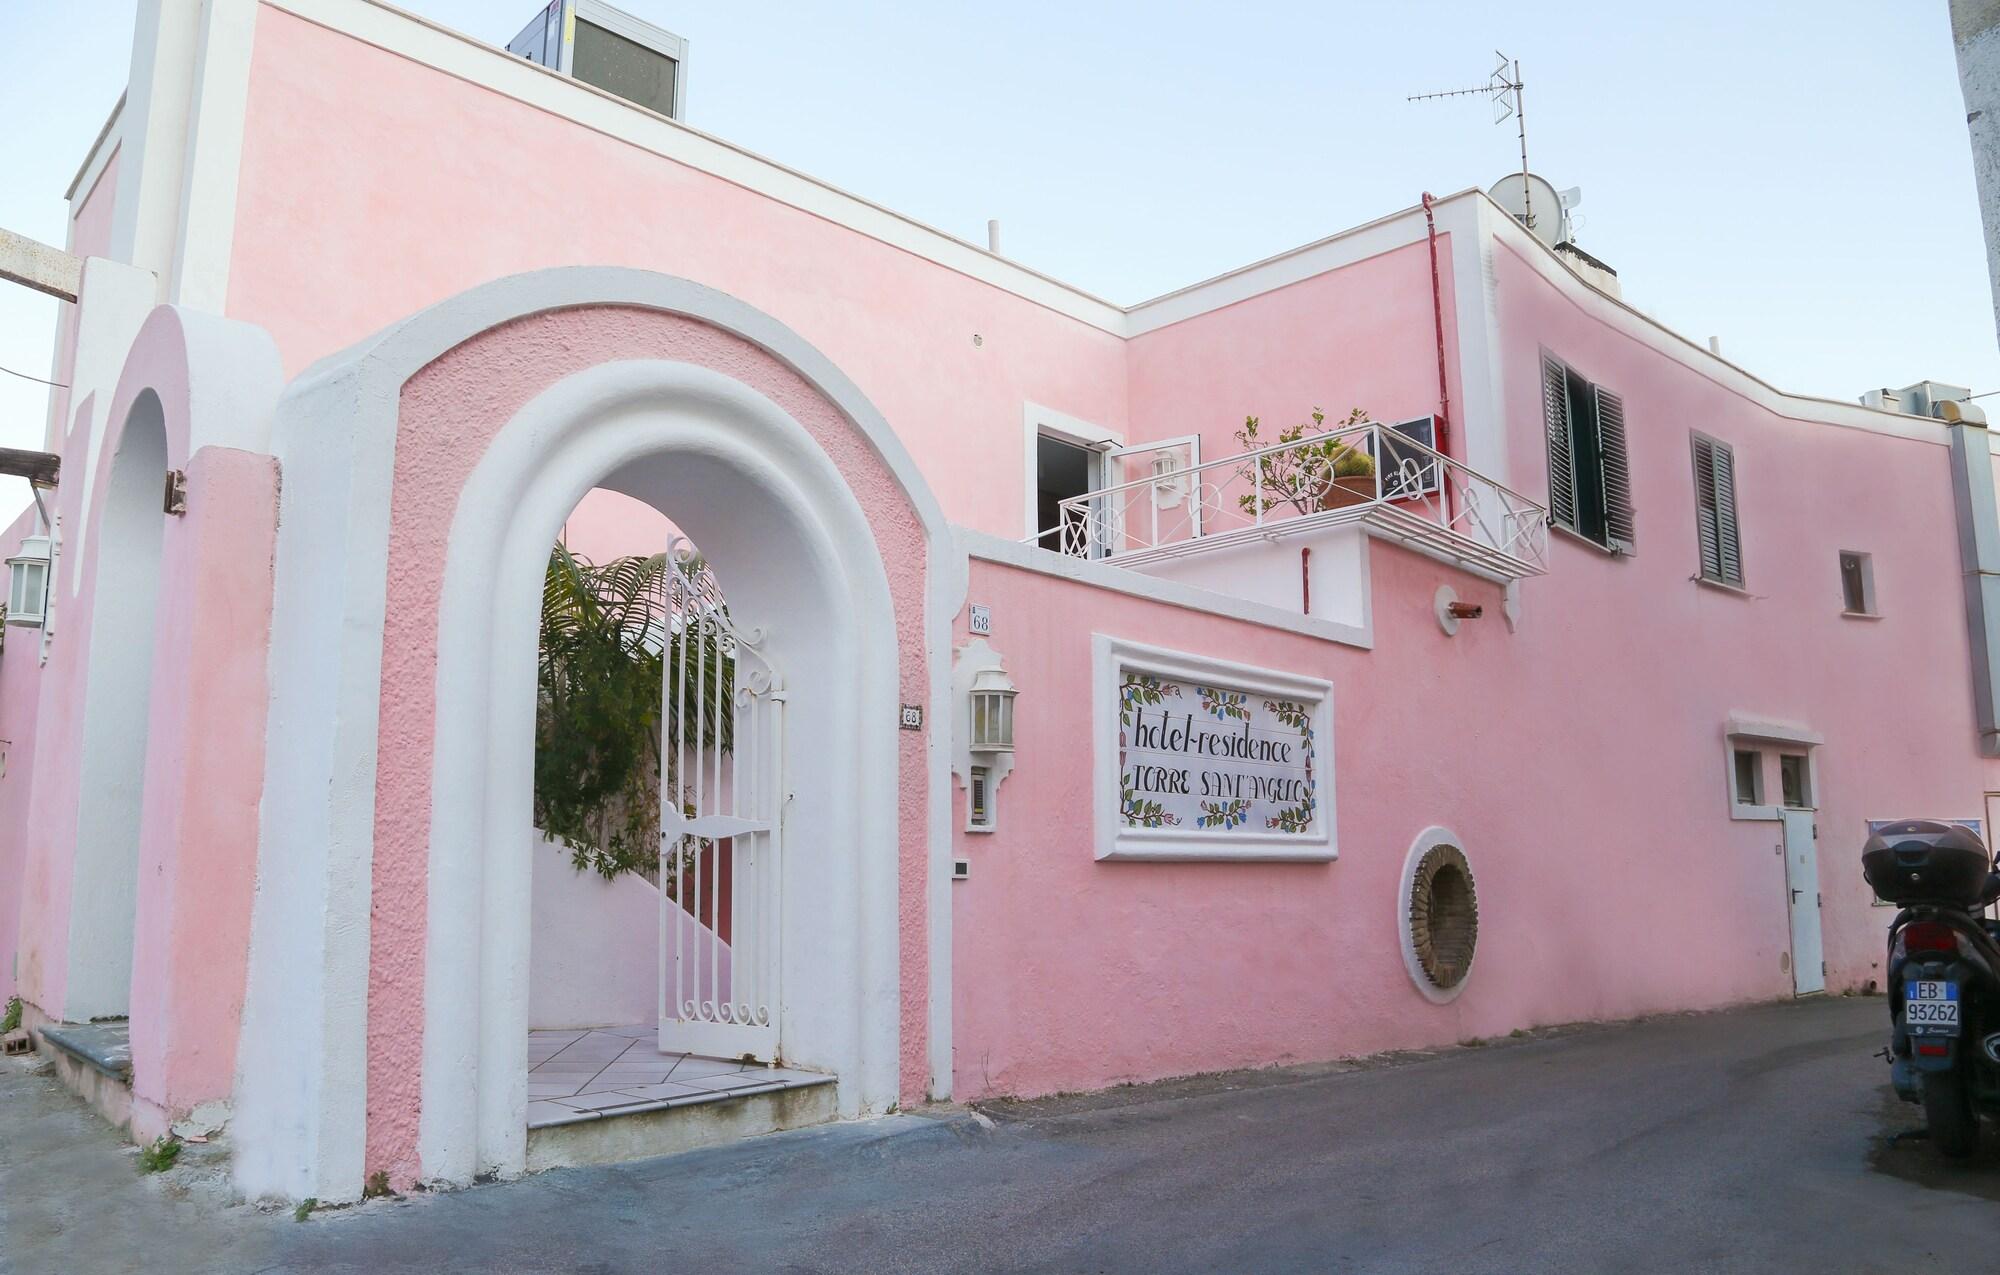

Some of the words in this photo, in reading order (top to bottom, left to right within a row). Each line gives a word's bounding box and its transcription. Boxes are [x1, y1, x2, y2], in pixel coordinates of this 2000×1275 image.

[973, 614, 989, 631] 68
[905, 710, 917, 723] 68
[1132, 764, 1191, 794] TORRE
[1918, 982, 1938, 999] EB
[1908, 1003, 1957, 1022] 93262
